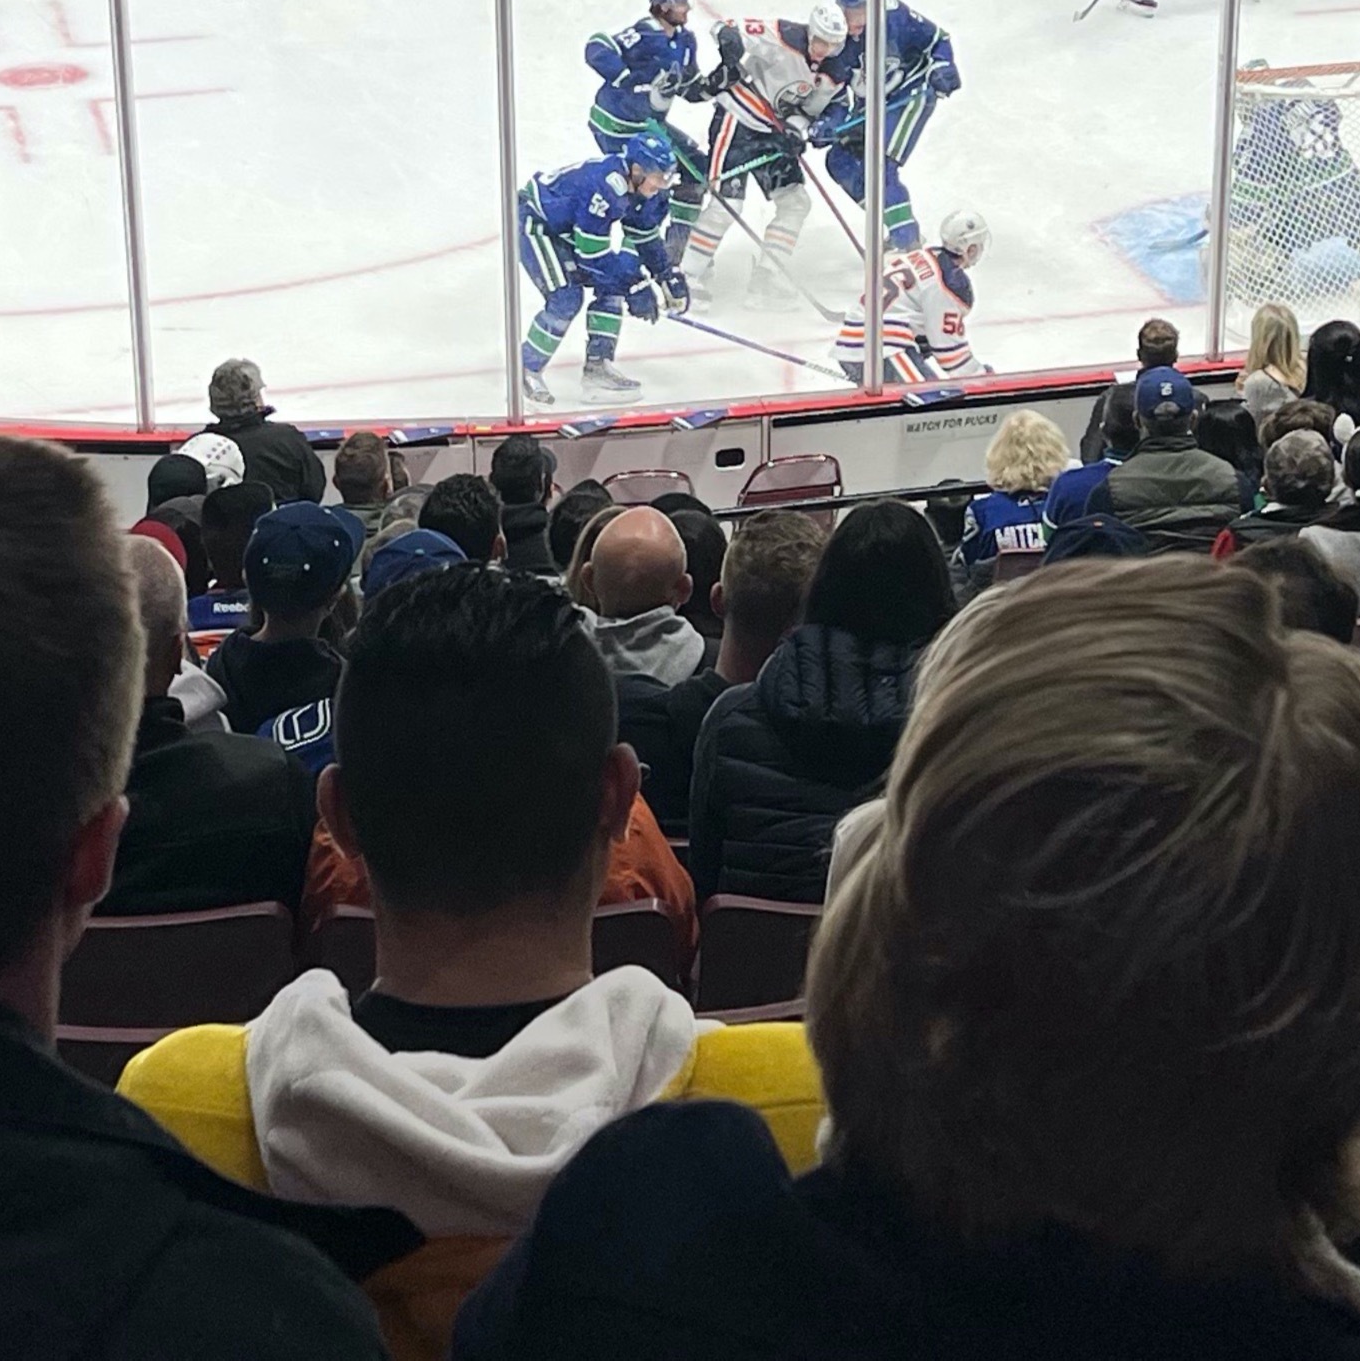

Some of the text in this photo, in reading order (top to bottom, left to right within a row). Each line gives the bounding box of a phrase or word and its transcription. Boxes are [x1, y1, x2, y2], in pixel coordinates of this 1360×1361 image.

[906, 413, 998, 432] WATCH FOR PUCKS
